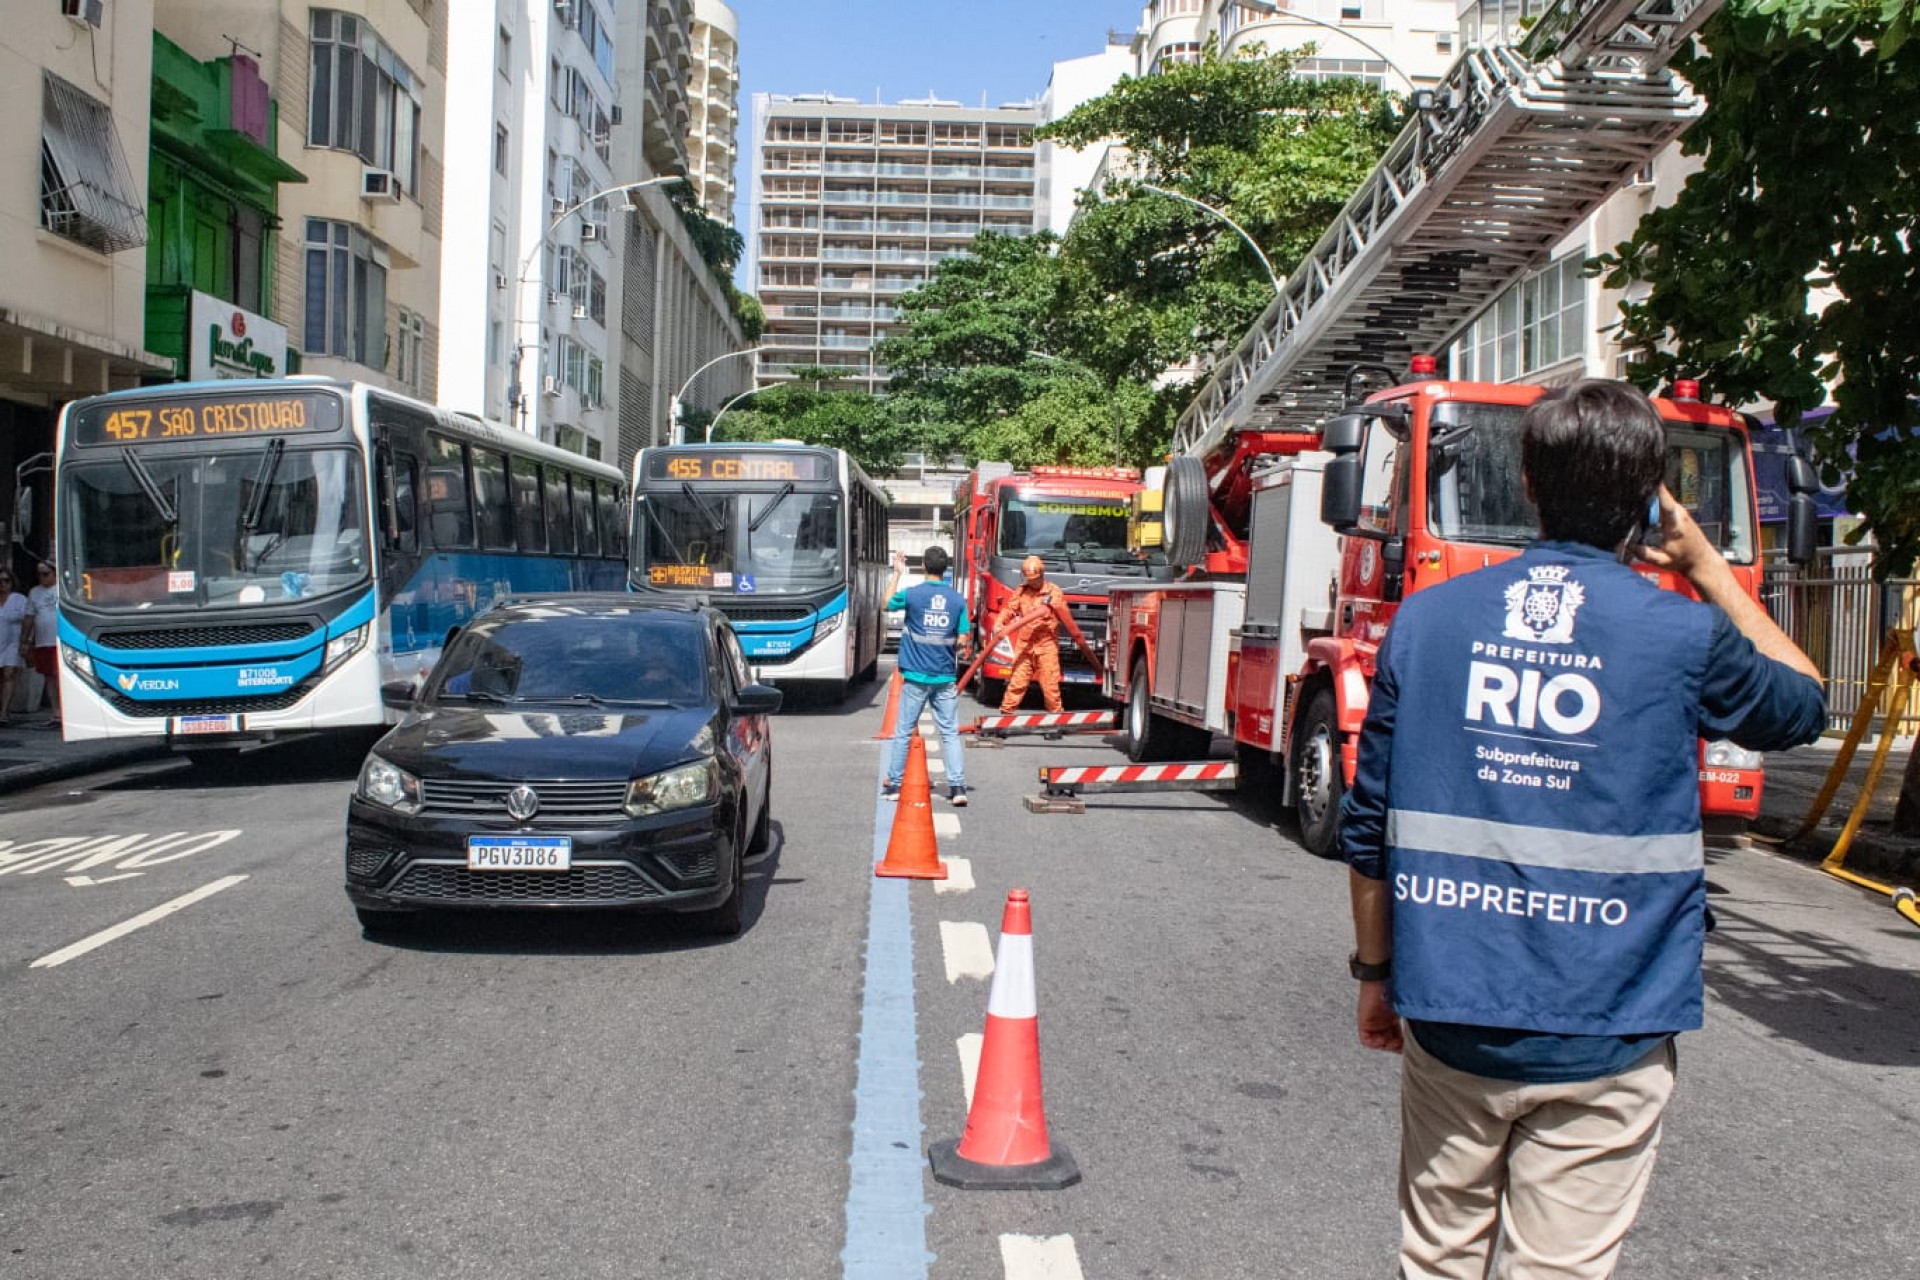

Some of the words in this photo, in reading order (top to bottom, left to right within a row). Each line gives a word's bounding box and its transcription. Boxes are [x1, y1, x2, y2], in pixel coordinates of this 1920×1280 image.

[105, 410, 152, 439] 457
[160, 407, 195, 437] SÃO
[667, 459, 701, 478] 455
[712, 459, 799, 479] CENTRAL
[923, 613, 949, 627] RIO
[1471, 641, 1603, 669] PREFEITURA
[138, 679, 179, 690] VERDUN
[1465, 661, 1600, 734] RIO
[1475, 745, 1580, 772] Subprefeitura
[1477, 765, 1498, 781] da
[1502, 769, 1542, 787] Zona
[1546, 774, 1571, 790] Sul
[478, 847, 558, 866] PGV3D86
[1395, 873, 1628, 926] SUBPREFEITO
